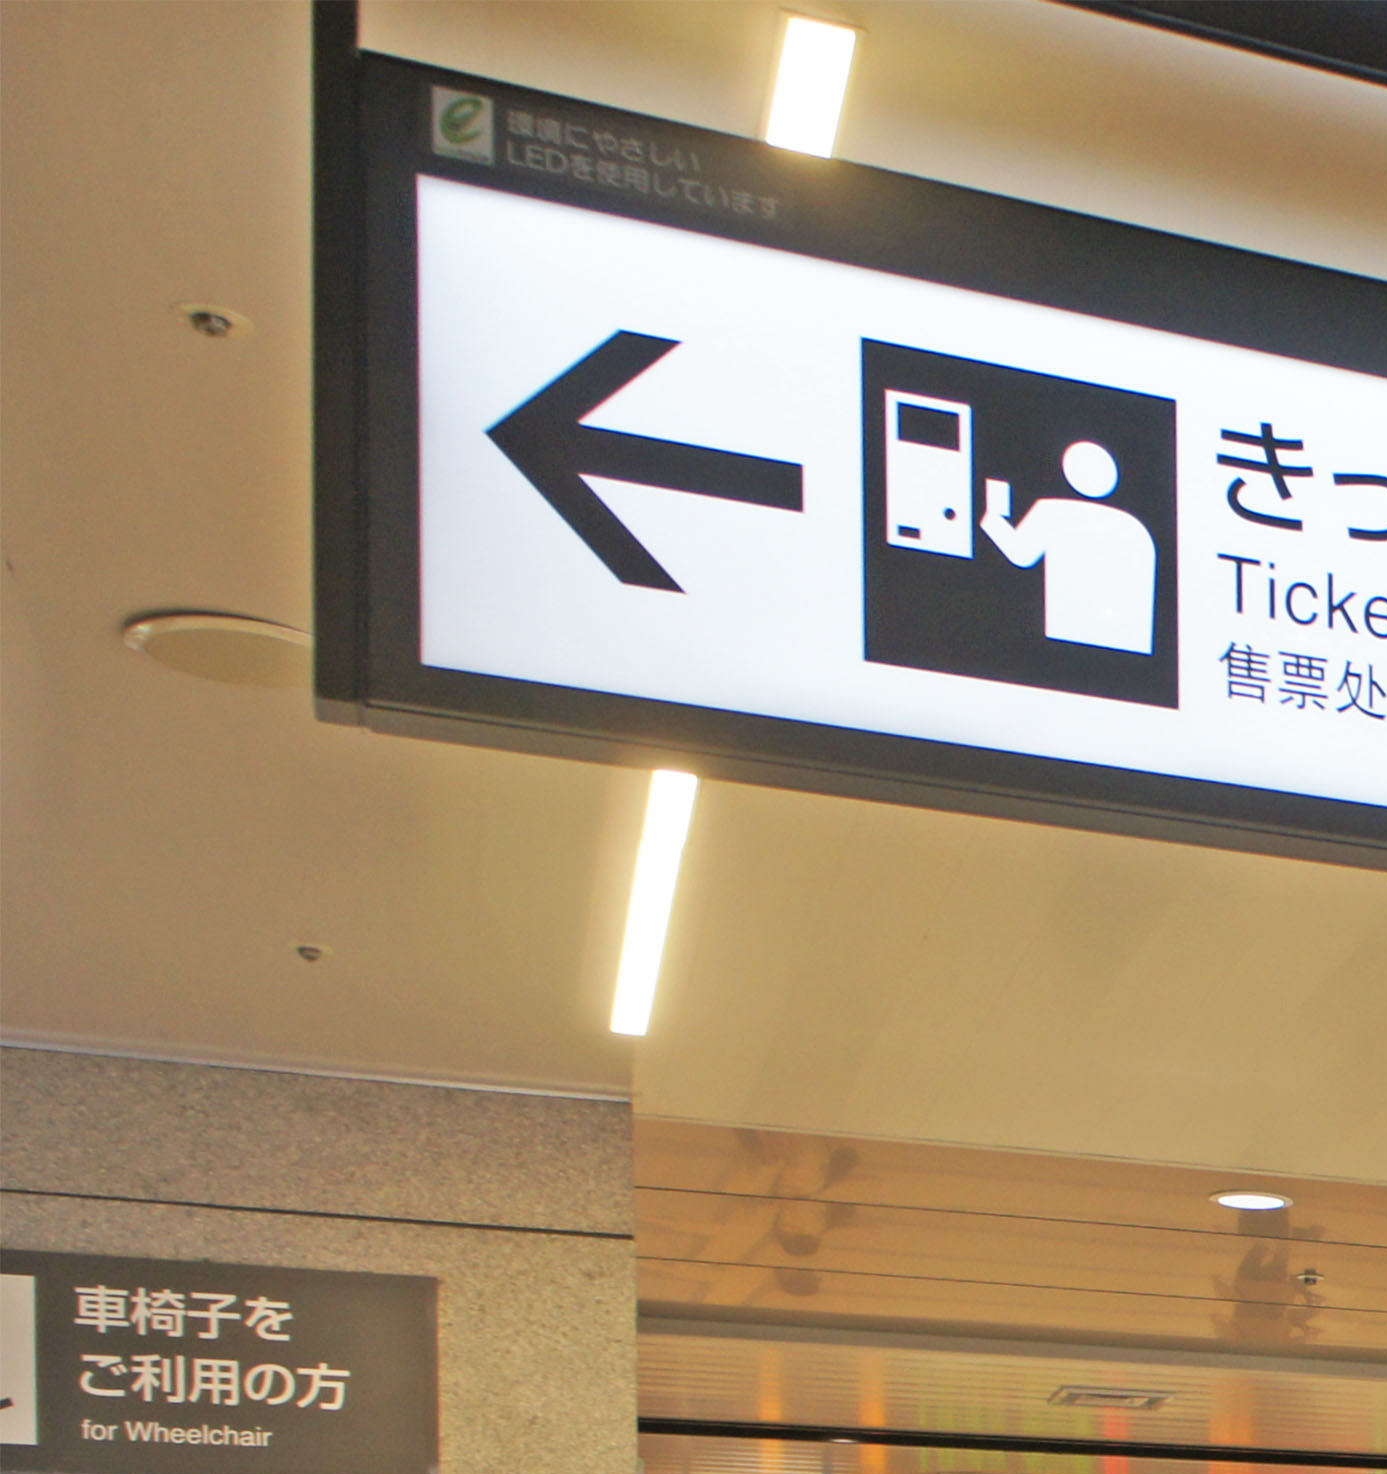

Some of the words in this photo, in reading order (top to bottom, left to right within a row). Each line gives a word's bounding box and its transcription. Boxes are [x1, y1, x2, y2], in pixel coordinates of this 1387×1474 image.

[507, 140, 780, 219] LEDを使用しています
[1218, 642, 1387, 721] 售票处
[74, 1285, 293, 1342] 車椅子を
[79, 1353, 352, 1411] ご利用の方
[81, 1419, 118, 1442] for
[126, 1421, 274, 1448] Wheelchair
